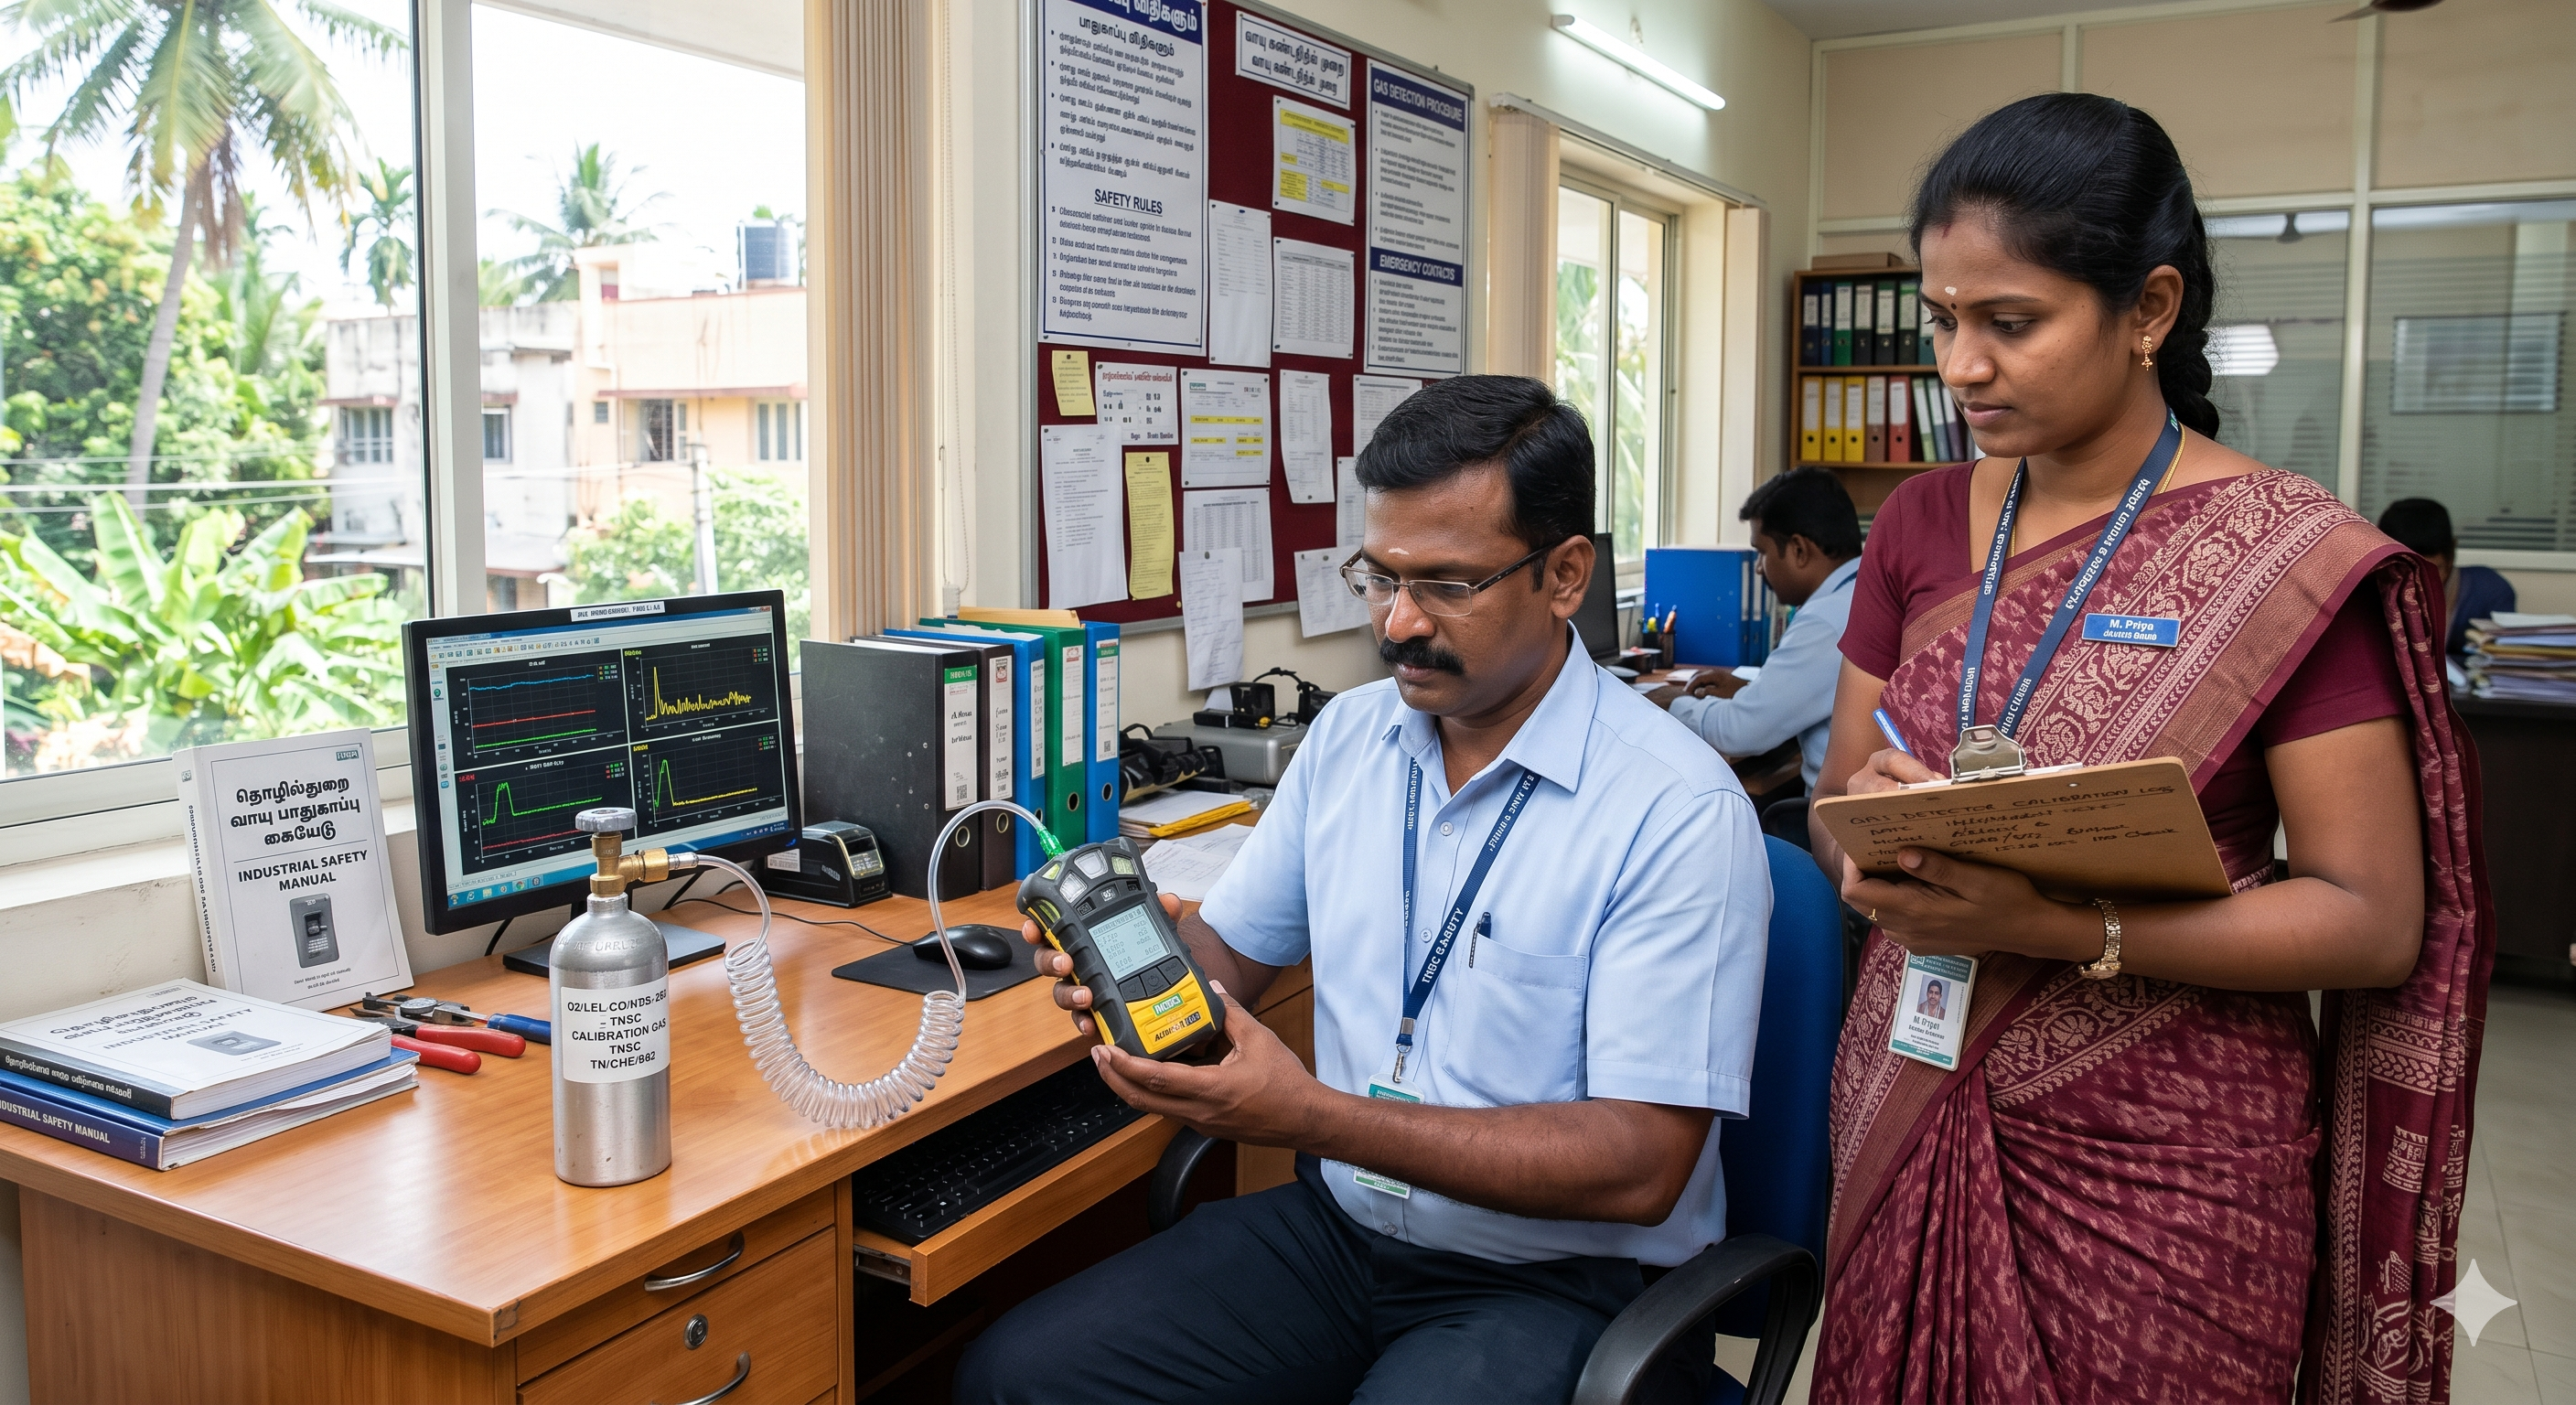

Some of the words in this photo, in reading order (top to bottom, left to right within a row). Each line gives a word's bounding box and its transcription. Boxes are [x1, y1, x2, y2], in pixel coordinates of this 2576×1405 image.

[1373, 78, 1389, 96] GAS
[1094, 188, 1132, 208] SAFETY
[1133, 196, 1163, 214] RULES
[1379, 253, 1422, 273] EMERGENCY
[2109, 619, 2122, 628] M.
[2125, 619, 2154, 632] Priya
[236, 778, 349, 806] தொழில்துறை
[231, 810, 274, 828] வாயு
[277, 796, 360, 822] பாதுகாப்பு
[1901, 804, 1996, 820] DETECTOR
[2012, 789, 2129, 807] CALIBRATION
[264, 820, 337, 845] கையேடு
[238, 858, 318, 883] INDUSTRIAL
[321, 850, 368, 868] SAFETY
[279, 872, 337, 892] MANUAL
[572, 1025, 649, 1041] CALIBRATION
[651, 1018, 667, 1032] GAS
[610, 1013, 642, 1025] TNSC
[609, 1041, 641, 1054] TNSC
[0, 1099, 40, 1121] DUSTRIAL
[75, 1123, 111, 1144] MANUAL
